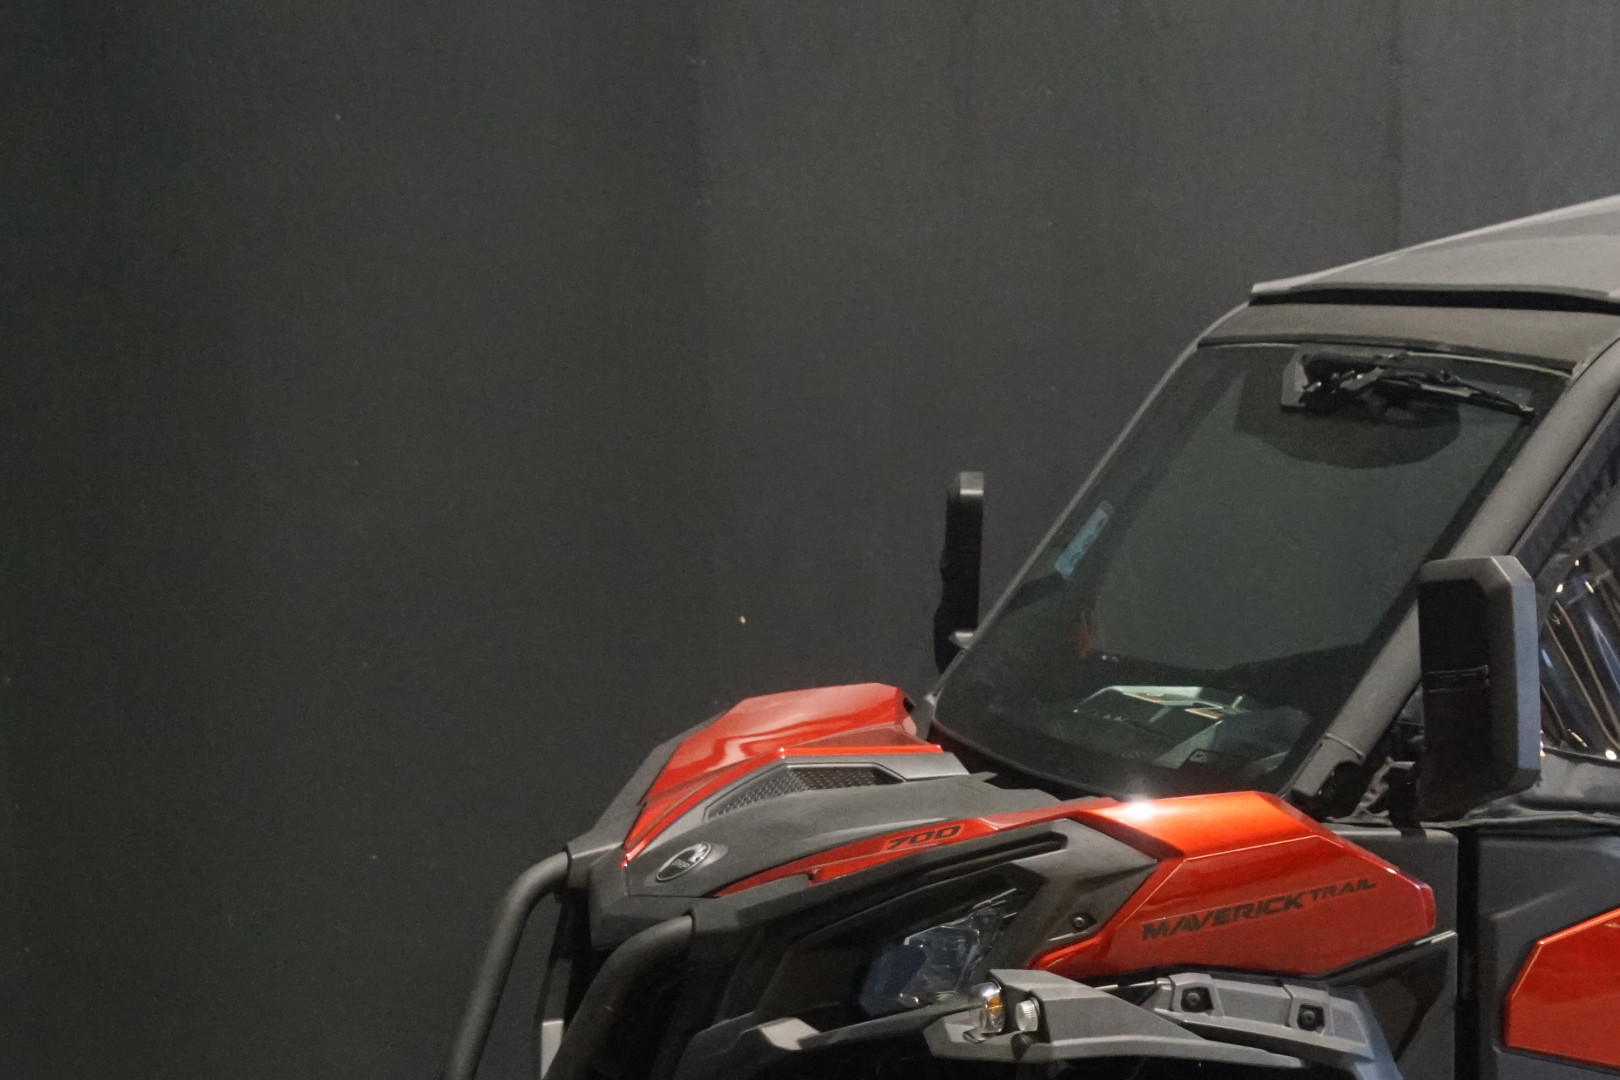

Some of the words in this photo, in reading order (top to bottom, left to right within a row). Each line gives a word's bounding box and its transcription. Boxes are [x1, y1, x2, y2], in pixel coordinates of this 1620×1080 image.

[887, 824, 962, 850] 700
[1141, 892, 1305, 941] MAVERICK
[1309, 878, 1378, 902] TRAIL
